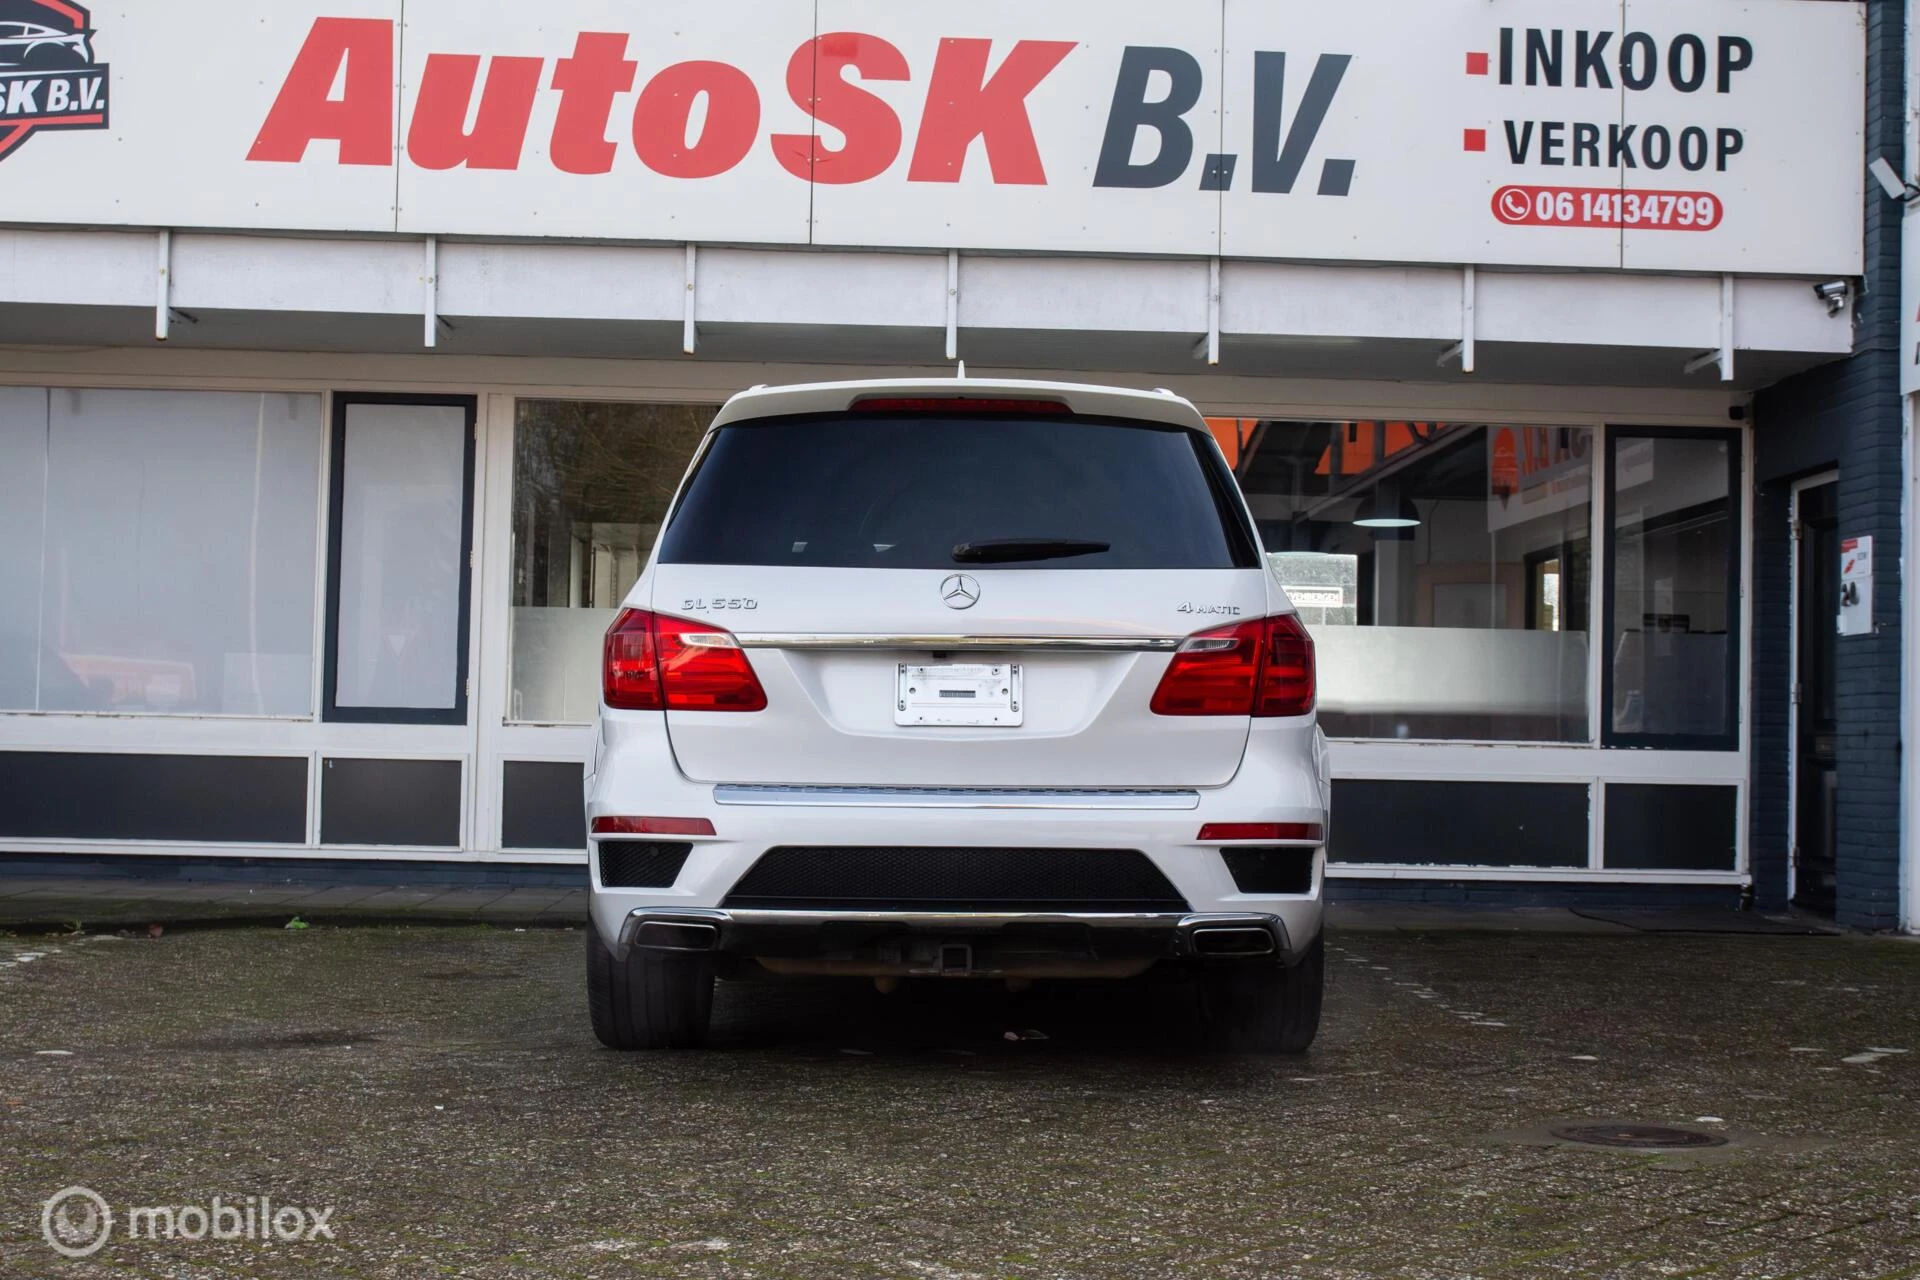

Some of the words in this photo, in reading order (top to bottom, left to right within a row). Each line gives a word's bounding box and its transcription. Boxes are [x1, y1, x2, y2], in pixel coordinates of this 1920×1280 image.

[1499, 27, 1754, 94] INKOOP
[46, 76, 105, 112] B.V.
[245, 16, 1079, 186] AutoSK
[1092, 45, 1356, 197] B.V.
[1503, 120, 1744, 171] VERKOOP
[1535, 191, 1574, 221] 06
[1580, 193, 1715, 226] 14134799
[711, 597, 758, 610] 550
